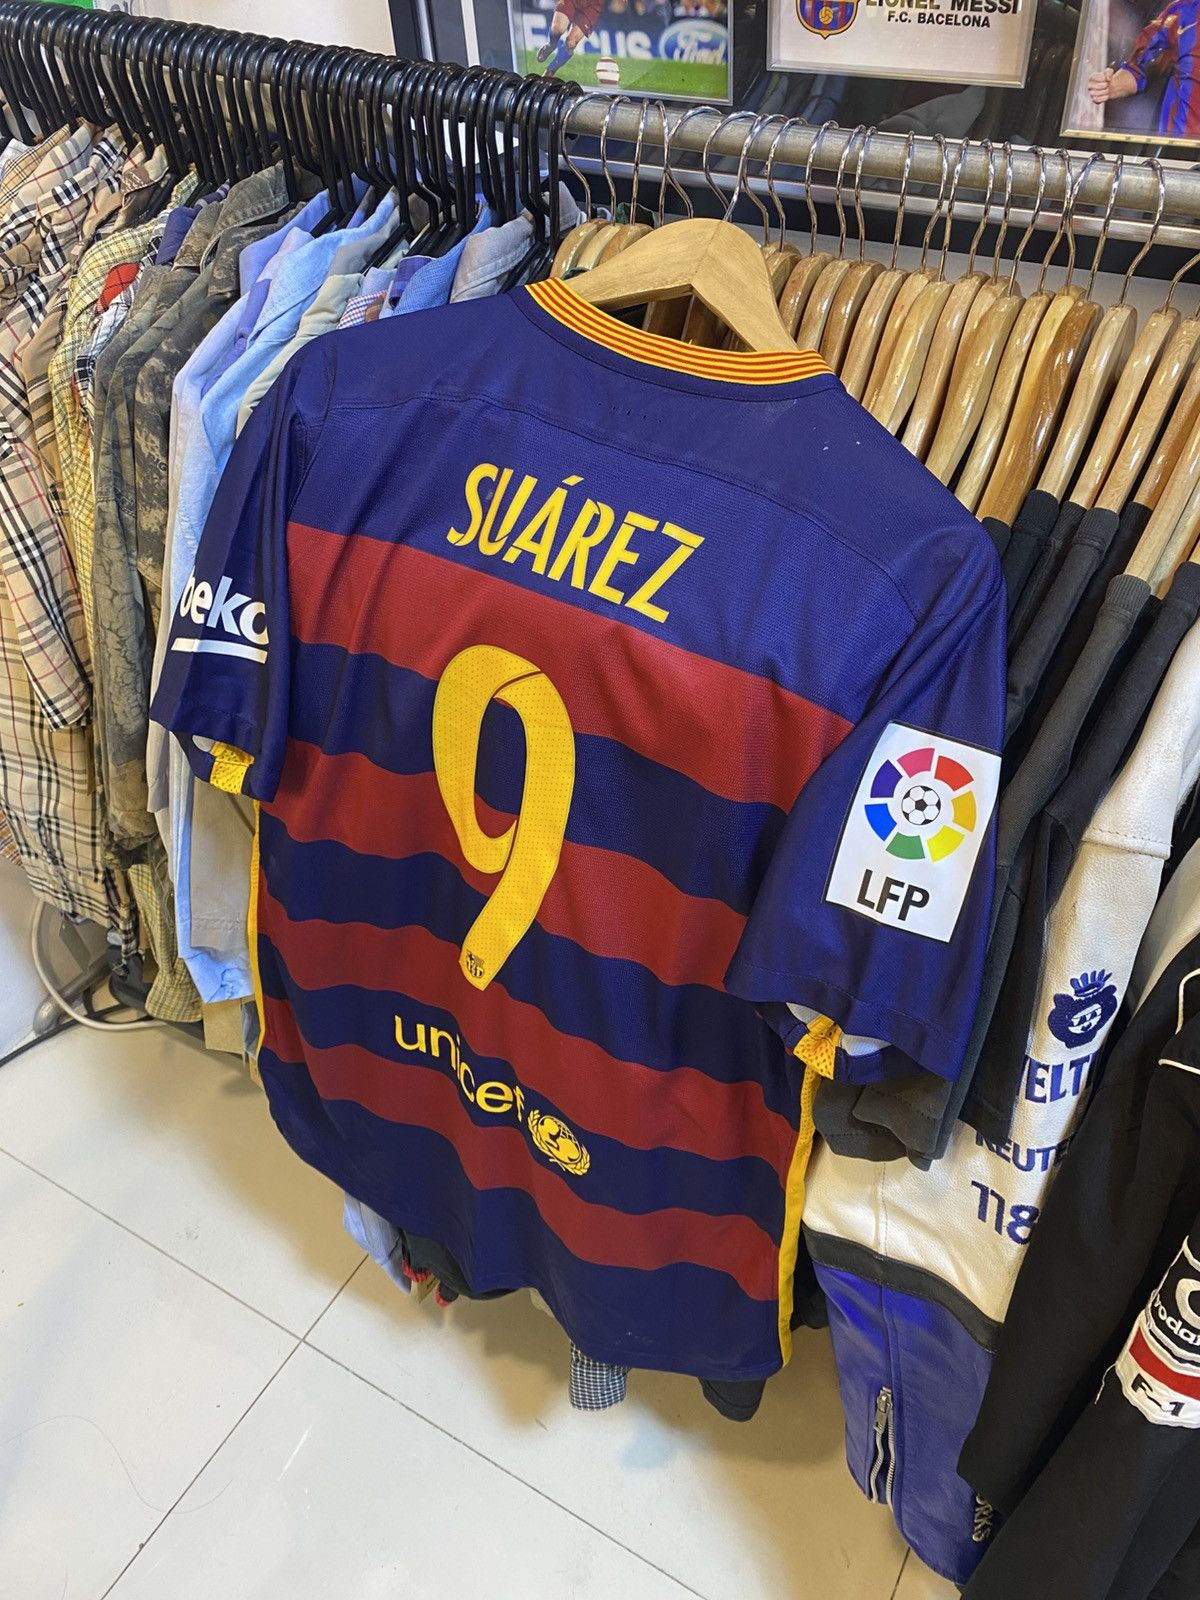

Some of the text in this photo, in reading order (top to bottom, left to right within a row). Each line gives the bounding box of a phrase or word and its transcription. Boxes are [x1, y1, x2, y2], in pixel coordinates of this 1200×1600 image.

[887, 10, 991, 28] F.C. BACELONA
[950, 0, 1018, 14] MESSI
[522, 12, 653, 59] FCUS
[446, 463, 705, 623] SUÁREZ
[432, 644, 576, 992] 9
[856, 868, 930, 922] LFP
[394, 1014, 525, 1122] unicef
